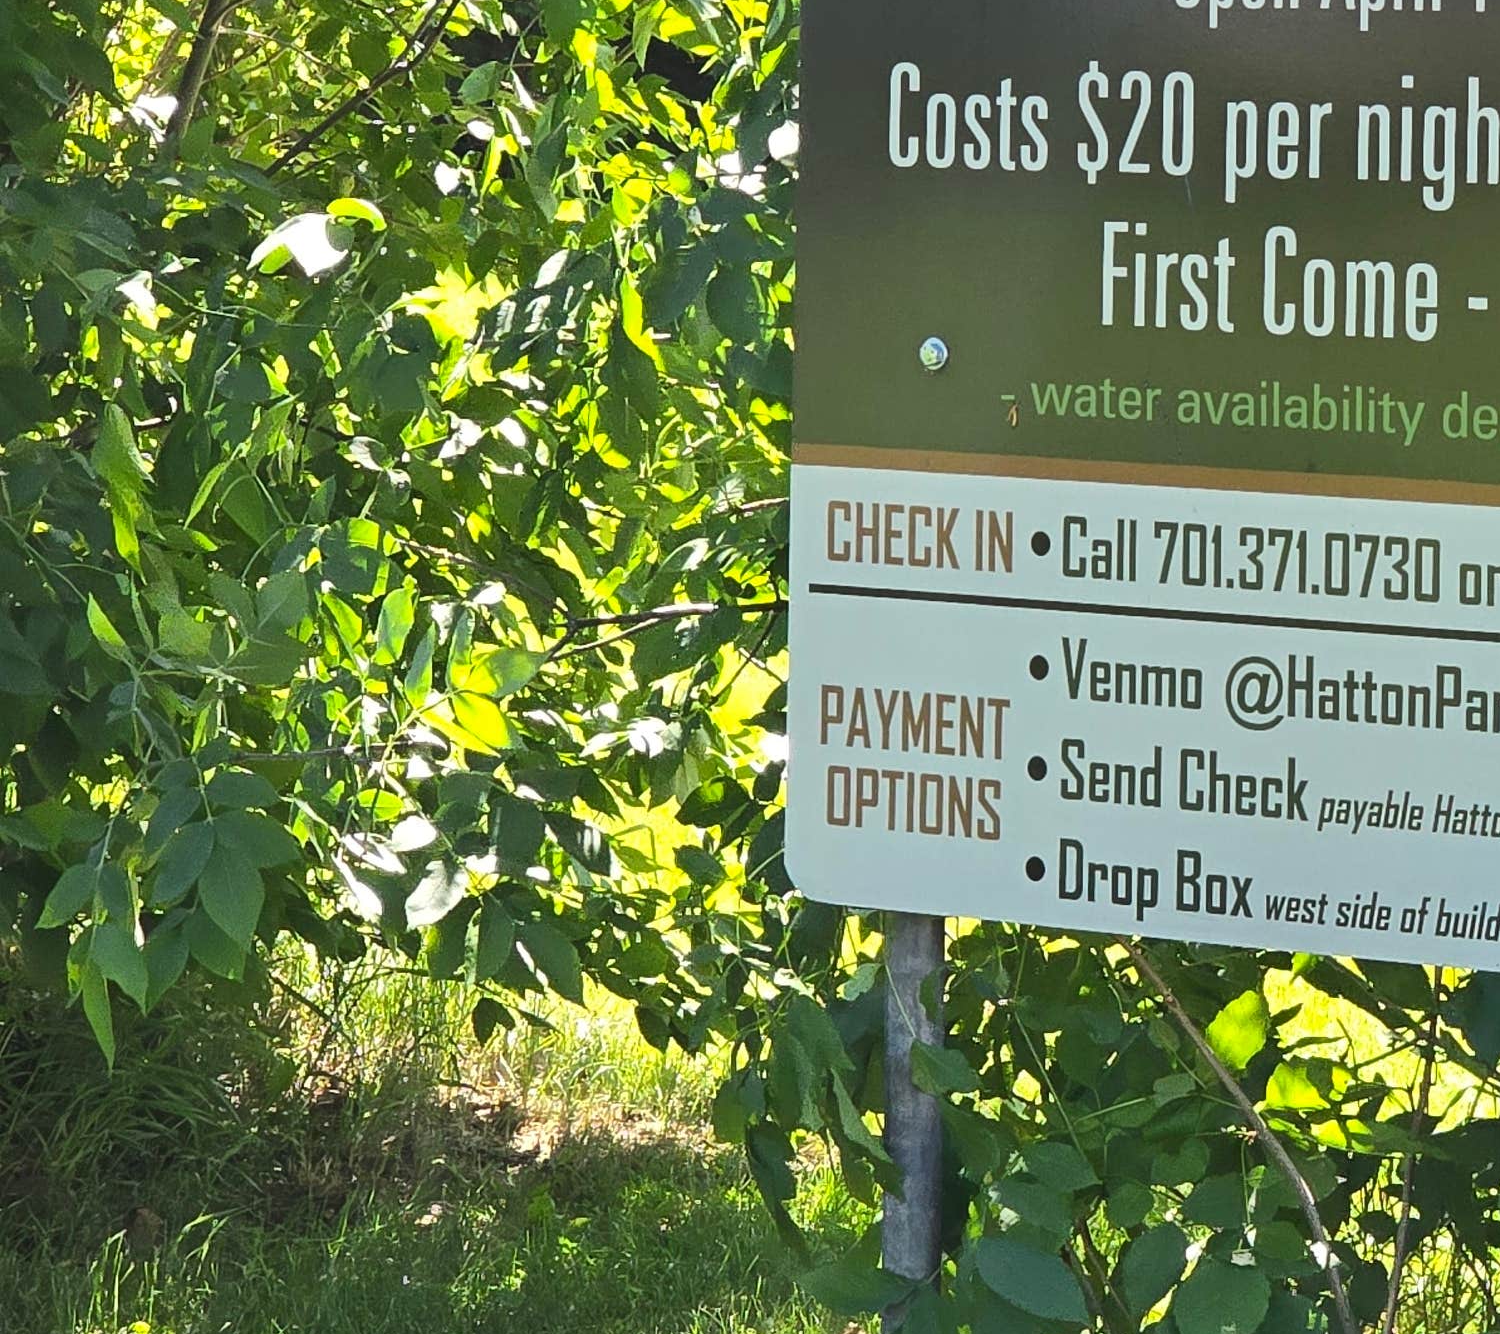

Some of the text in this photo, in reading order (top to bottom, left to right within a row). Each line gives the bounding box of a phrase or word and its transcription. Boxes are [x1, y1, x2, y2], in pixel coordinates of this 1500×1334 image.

[889, 62, 1048, 171] Costs
[1078, 61, 1194, 184] $20
[1225, 101, 1332, 203] per
[1102, 222, 1235, 332] First
[1264, 226, 1437, 341] Come
[1031, 379, 1162, 421] water
[1178, 381, 1425, 446] availability
[828, 501, 1013, 573] CHECK IN
[1063, 516, 1137, 582] Call
[1154, 521, 1440, 603] 701.371.0730
[1062, 637, 1202, 709] Venmo
[821, 684, 1010, 760] PAYMENT
[827, 766, 1001, 840] OPTIONS
[1061, 739, 1162, 807] Send
[1180, 749, 1308, 821] Check
[1317, 790, 1424, 834] payable
[1059, 841, 1159, 922] Drop
[1176, 849, 1253, 918] Box
[1266, 894, 1328, 925] west
[1336, 892, 1391, 931] side
[1400, 897, 1431, 934] of
